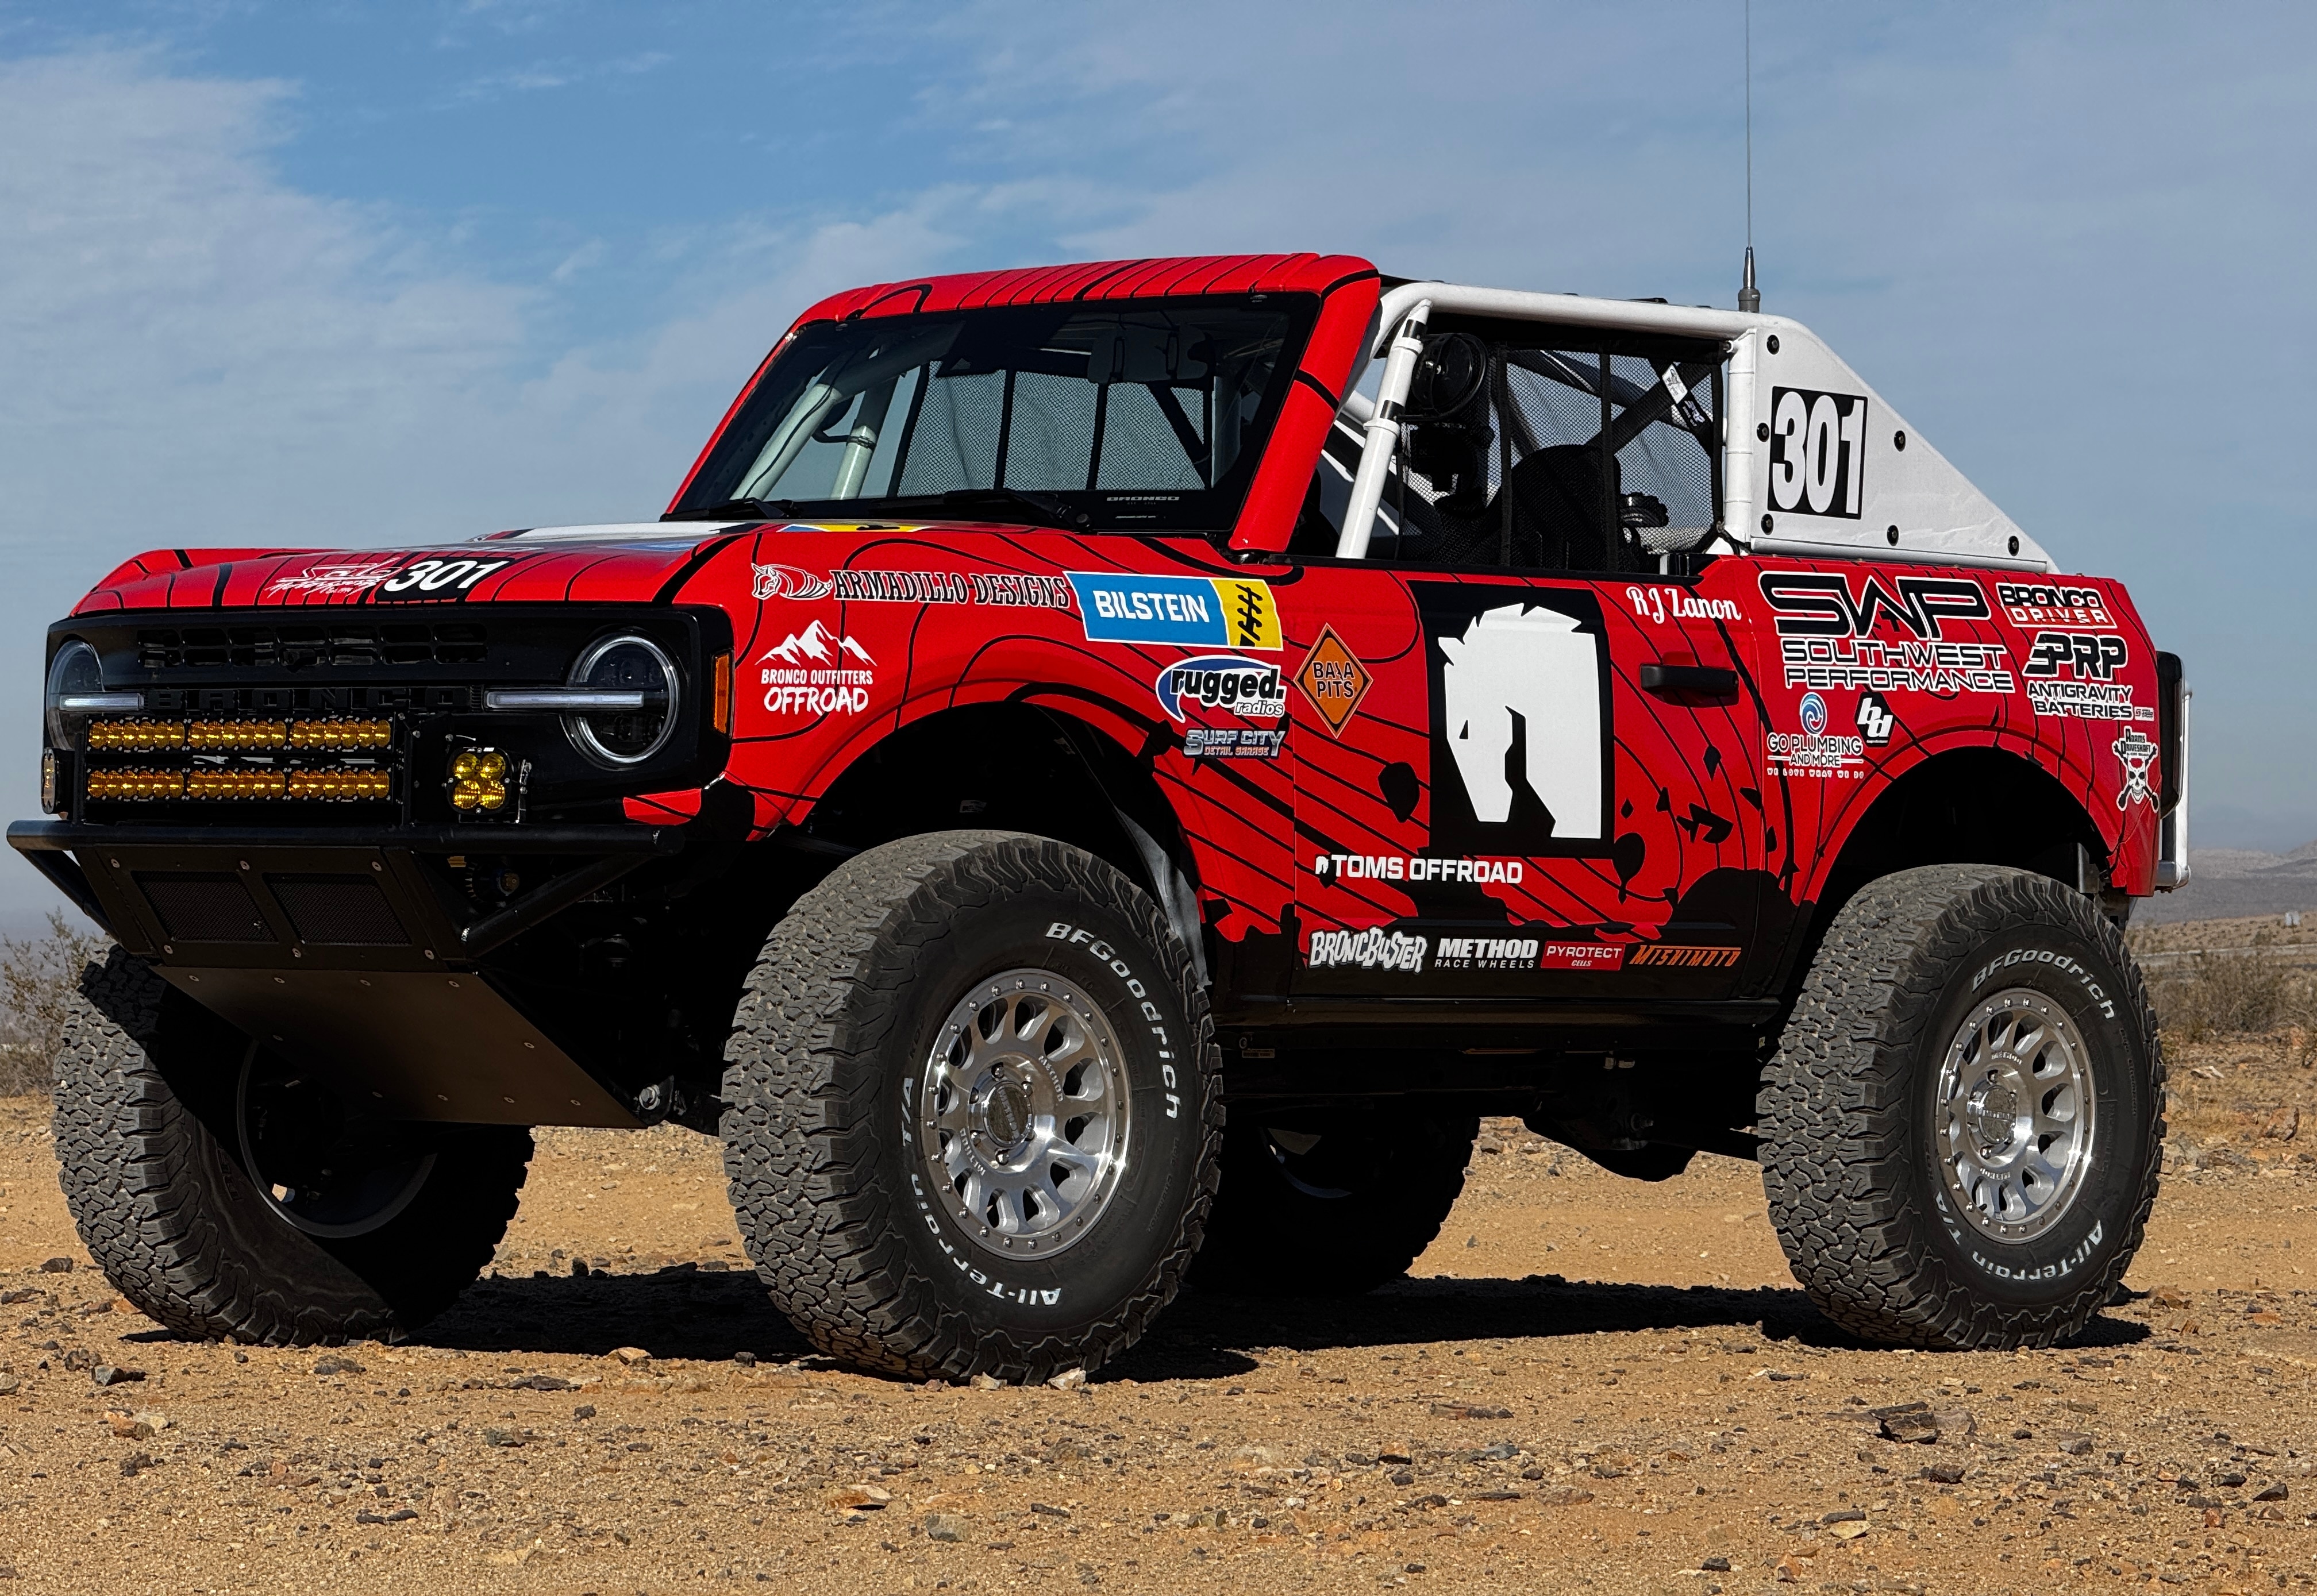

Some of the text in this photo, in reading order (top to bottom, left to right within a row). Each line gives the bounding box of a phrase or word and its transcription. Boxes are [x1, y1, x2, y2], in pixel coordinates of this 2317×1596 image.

[1772, 391, 1865, 514] 301
[384, 560, 510, 592] 301
[829, 570, 1070, 608] ARMADILLO DESIGNS
[1093, 590, 1210, 622] BILSTEIN
[1664, 588, 1742, 620] Zanon
[1758, 571, 1992, 641] SWP
[1997, 585, 2104, 608] BRONCO
[2011, 607, 2109, 624] DRIVER
[1781, 638, 2008, 670] SOUTHWEST
[2023, 631, 2127, 681] PRP
[761, 669, 873, 685] BRONCO OUTFITTERS
[1317, 680, 1354, 698] PITS
[1784, 666, 2015, 693] PERFORMANCE
[148, 689, 470, 711] BRONCO
[764, 686, 868, 716] OFFROAD
[2029, 682, 2133, 701] ANTIGRAVITY
[1235, 701, 1284, 716] radios
[2034, 700, 2132, 719] BATTERIES
[1183, 729, 1285, 757] SURF CITY
[1204, 746, 1269, 756] DETAIL GARAGE
[1768, 733, 1863, 755] GO PLUMBING
[1783, 768, 1804, 776] LOVE
[1790, 754, 1841, 766] AND MORE
[1331, 854, 1523, 884] TOMS OFFROAD
[1437, 938, 1538, 958] METHOD
[1546, 946, 1622, 959] PYROTECT
[1629, 945, 1742, 967] MISHIMOTO
[1434, 959, 1534, 969] RACE WHEELS
[1571, 959, 1592, 967] CELLS
[1972, 949, 2116, 1020] BFGoodrich
[1045, 922, 1180, 1119] BFGoodrich
[1038, 1055, 1064, 1102] METHOD
[960, 1127, 986, 1176] METHOD
[901, 1077, 1062, 1306] All-Terrain T/A
[1935, 1191, 2103, 1281] All-Terrain T/A
